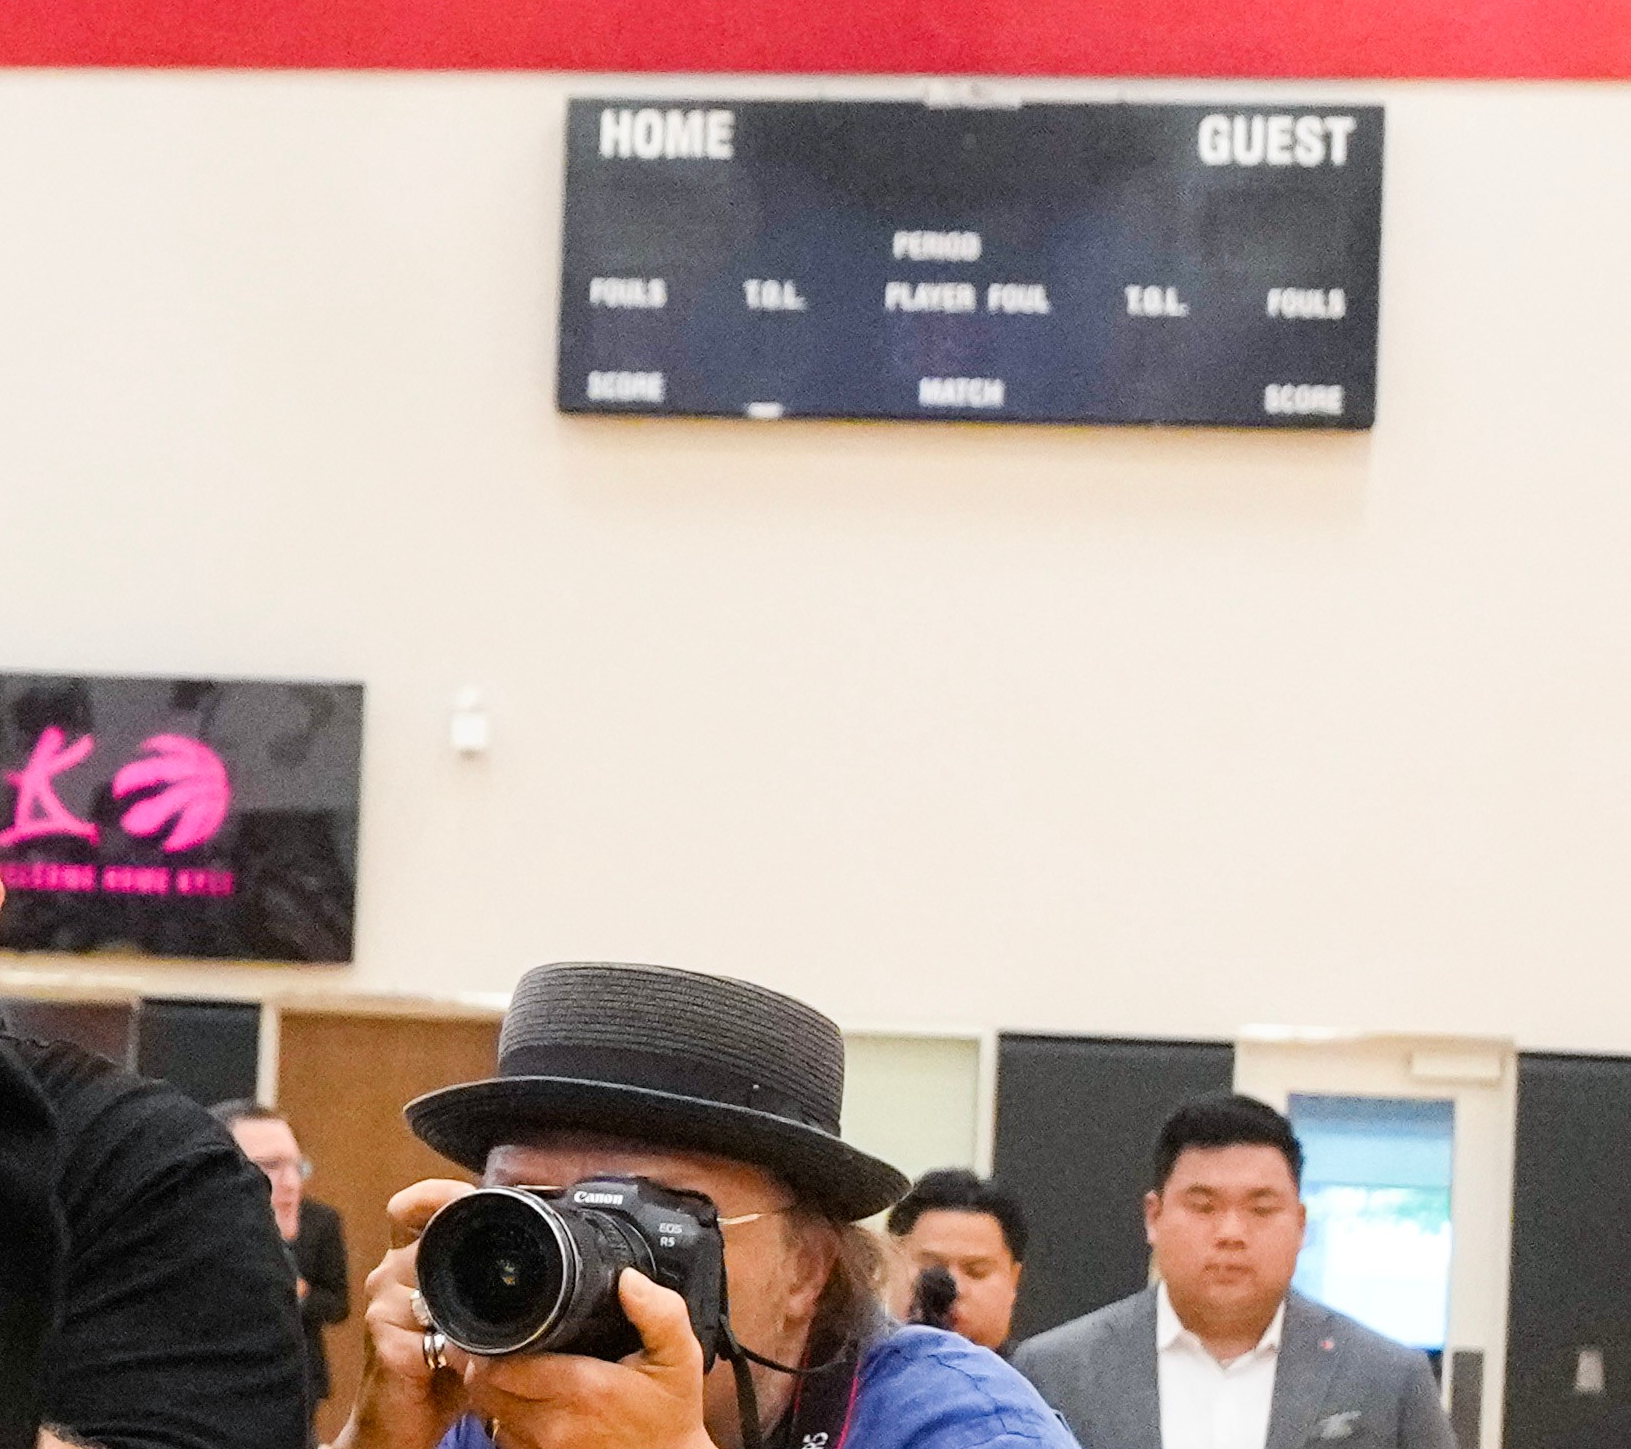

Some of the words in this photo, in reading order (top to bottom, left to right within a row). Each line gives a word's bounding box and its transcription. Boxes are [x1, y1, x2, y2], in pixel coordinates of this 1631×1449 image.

[601, 111, 733, 161] HOME
[1198, 115, 1357, 167] GUEST
[892, 230, 982, 262] PERIOD
[589, 277, 668, 310] FOULS
[885, 282, 976, 314] PLAYER
[987, 283, 1051, 315] FOUL
[1266, 287, 1347, 320] FOULS
[587, 371, 666, 403] SCORE
[919, 377, 1007, 408] MATCH
[1263, 382, 1345, 415] SCORE
[573, 1190, 624, 1205] Canon
[658, 1222, 684, 1235] EOS
[659, 1236, 676, 1248] R5
